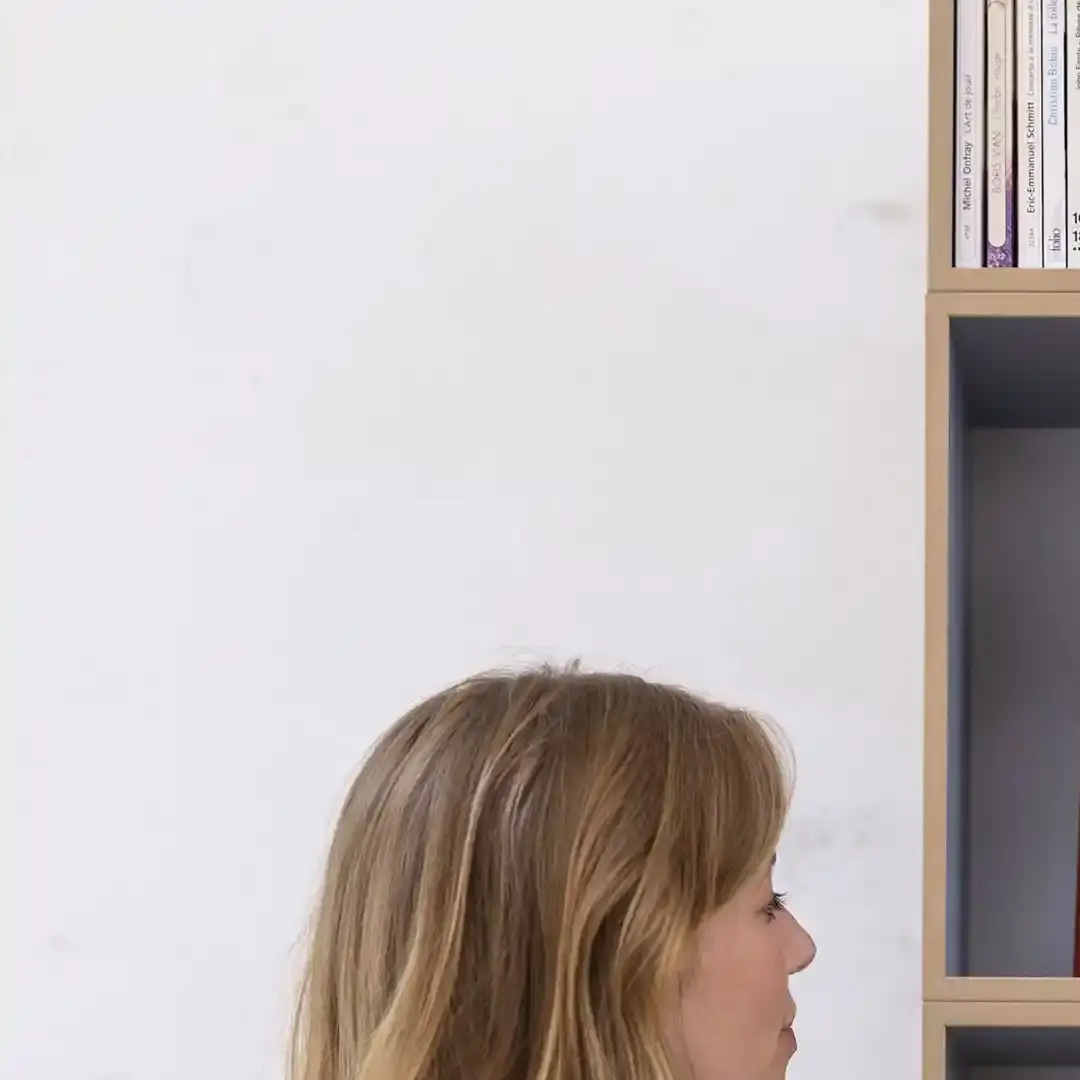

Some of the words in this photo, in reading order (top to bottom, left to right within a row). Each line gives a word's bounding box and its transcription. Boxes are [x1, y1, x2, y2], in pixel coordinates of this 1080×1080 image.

[1048, 23, 1059, 34] La
[963, 98, 972, 110] de
[1027, 101, 1035, 139] Schmitt
[963, 141, 973, 175] Onfray
[963, 178, 971, 210] Michel
[1027, 142, 1035, 214] Eric-Emmanuel
[1048, 229, 1060, 252] folio
